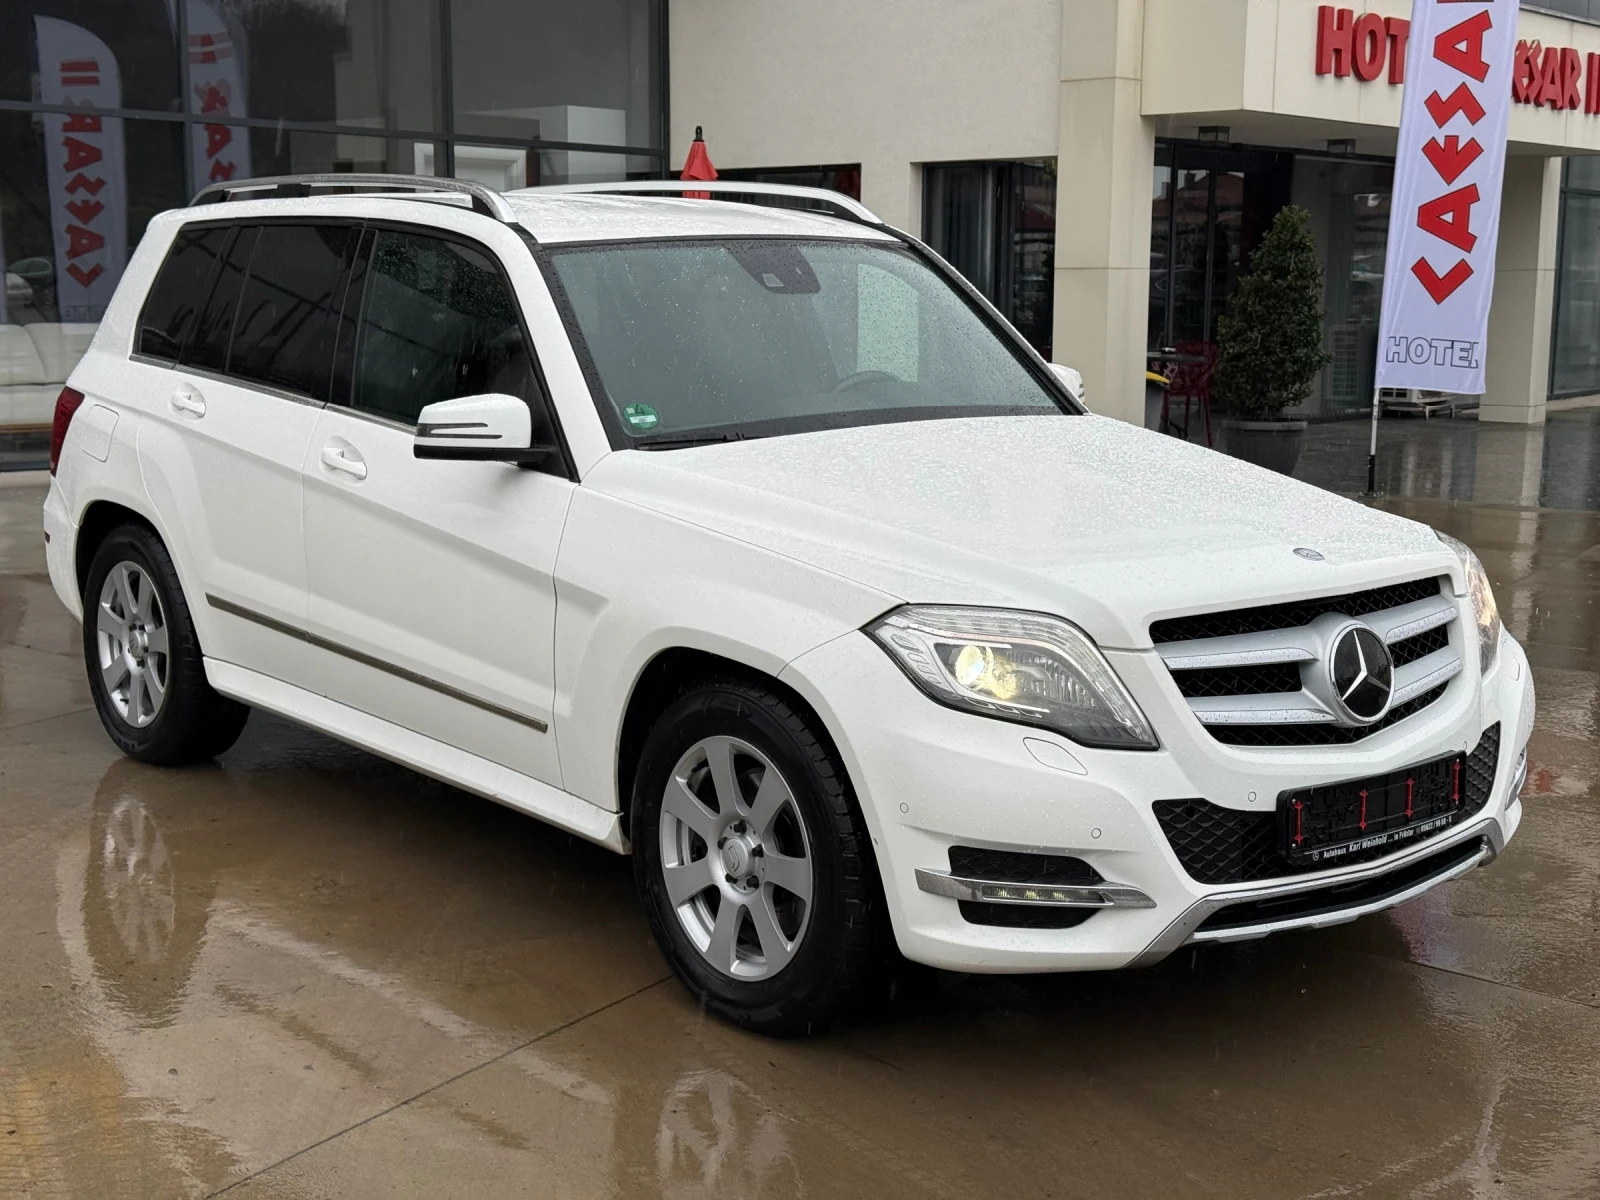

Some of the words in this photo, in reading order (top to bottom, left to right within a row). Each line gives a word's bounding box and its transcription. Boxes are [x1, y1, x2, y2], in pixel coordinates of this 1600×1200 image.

[1316, 5, 1410, 84] HOT
[1512, 39, 1581, 110] ESAR
[1410, 0, 1494, 305] CAESA
[1323, 847, 1347, 859] Autohaus
[1362, 834, 1388, 849] Weinhold
